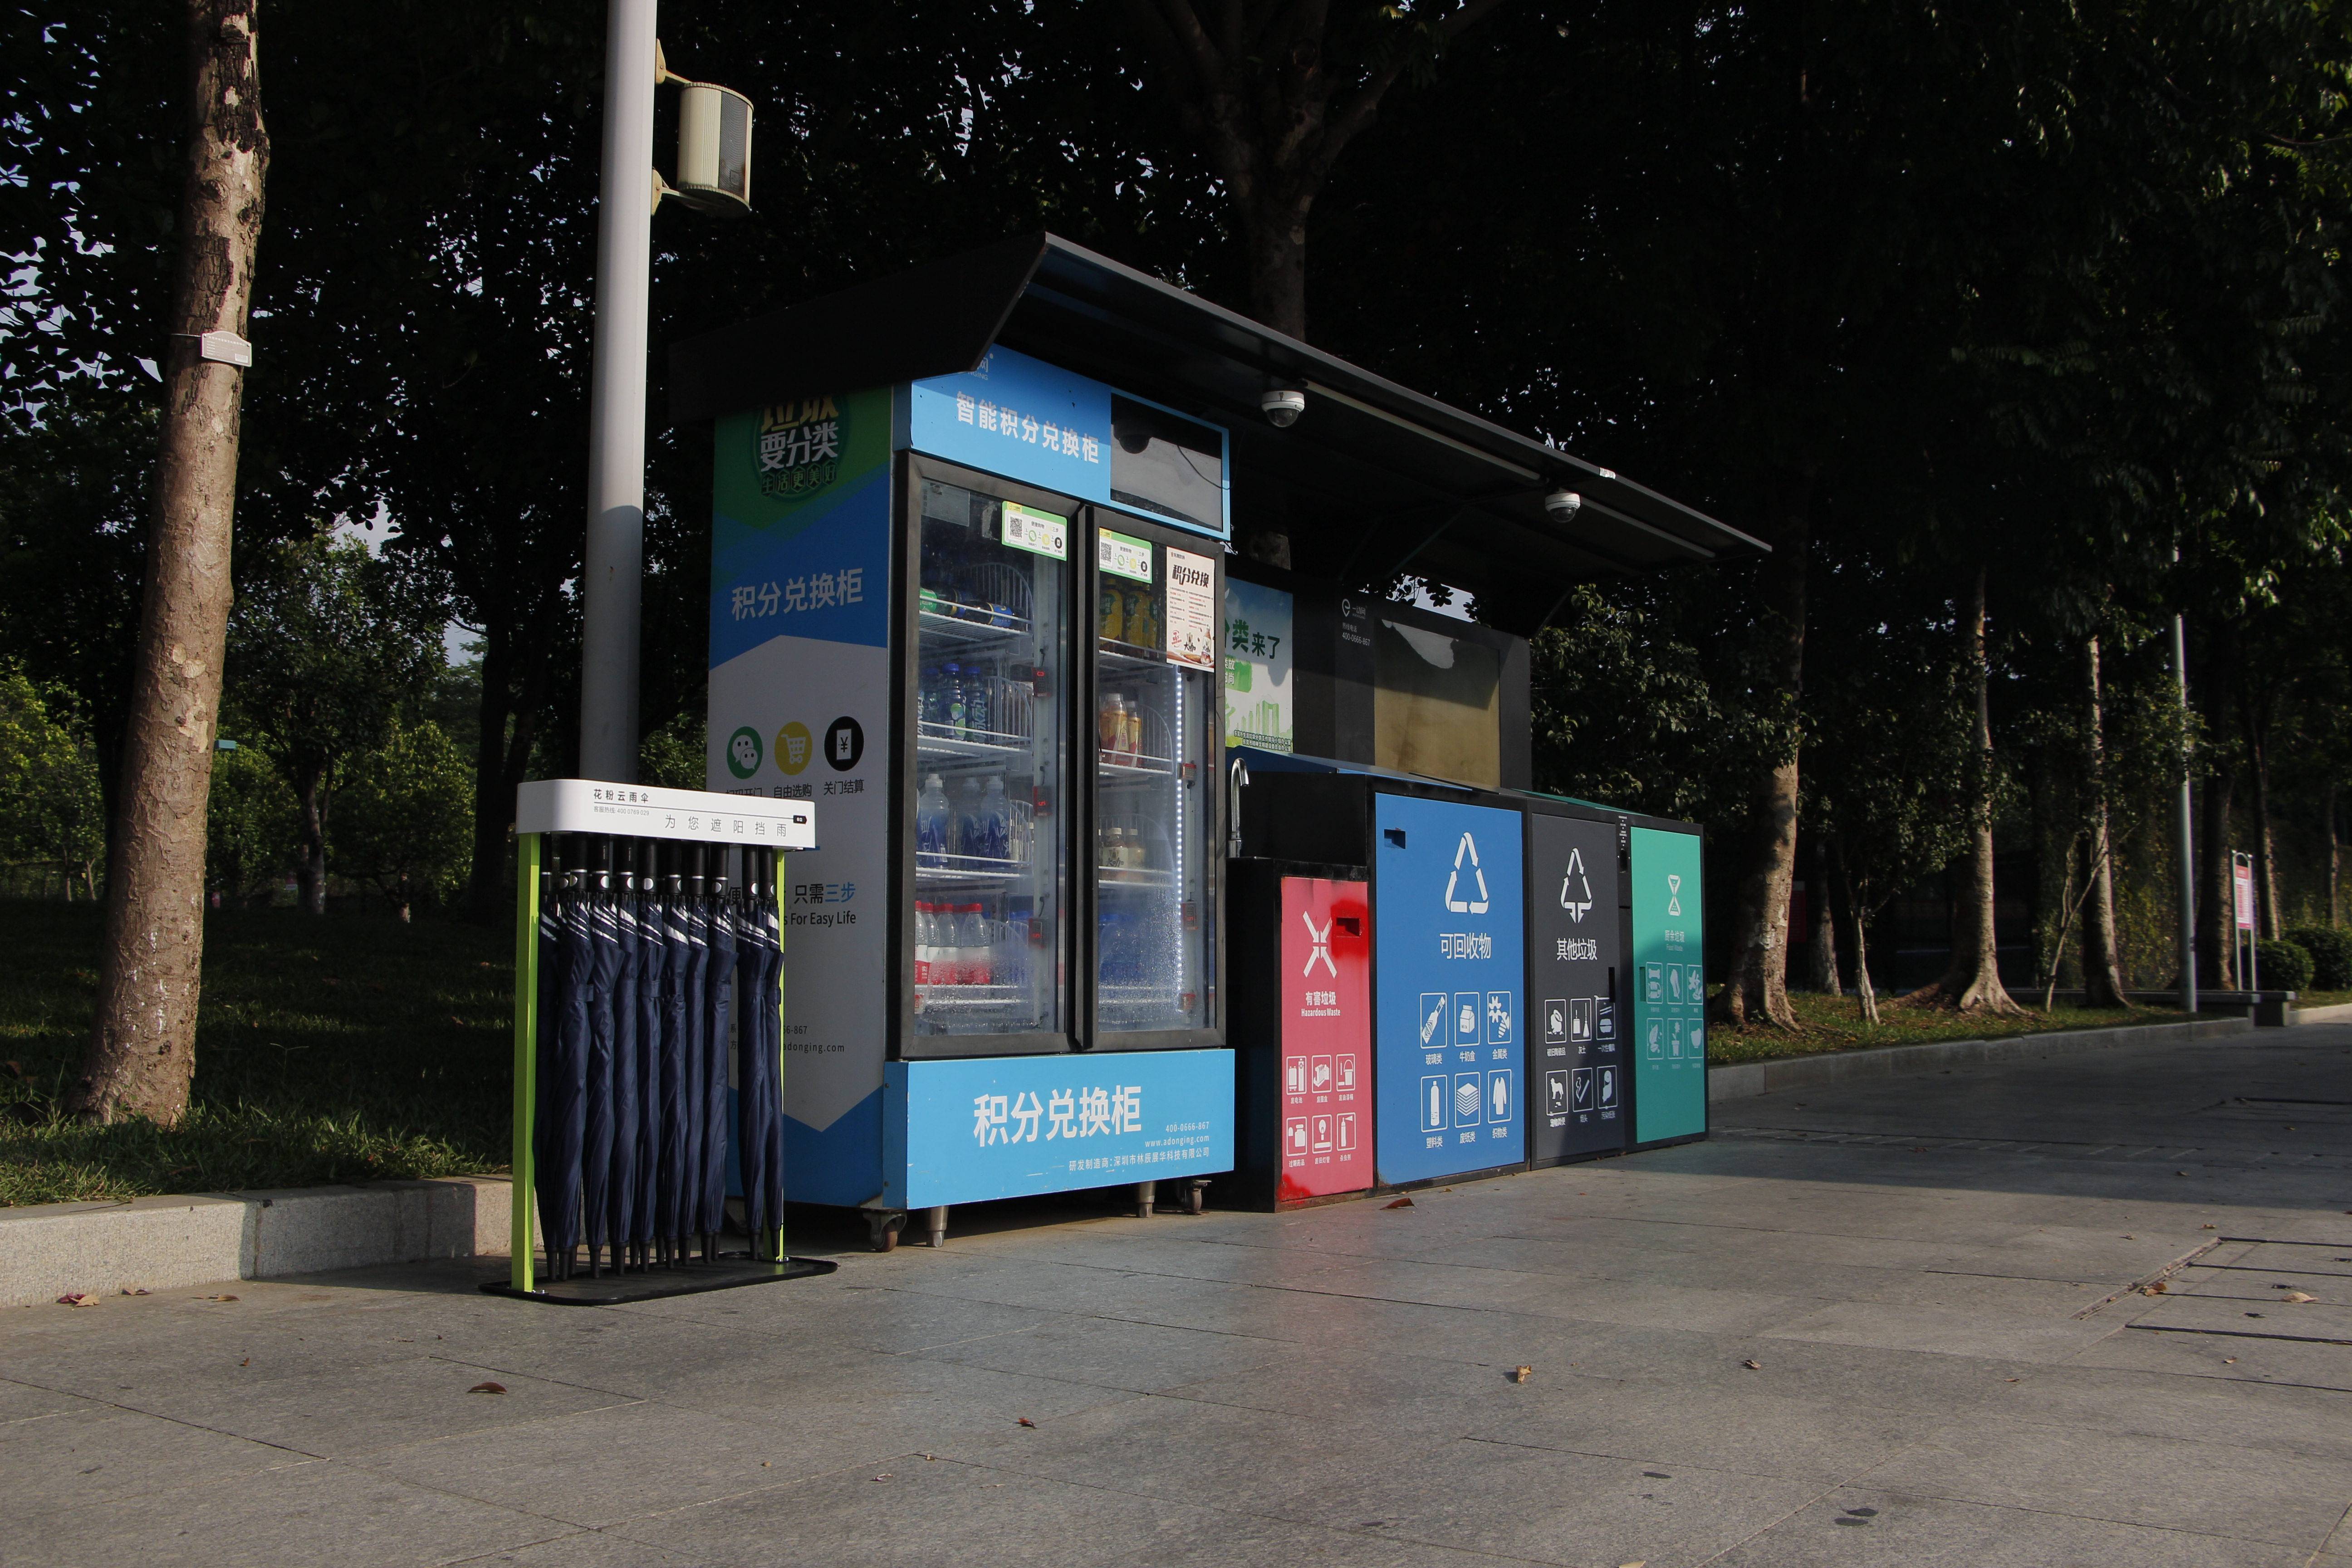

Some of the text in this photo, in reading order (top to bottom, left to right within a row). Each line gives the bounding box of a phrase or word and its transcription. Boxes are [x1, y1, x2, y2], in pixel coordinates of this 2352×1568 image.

[968, 371, 988, 381] GING
[956, 391, 1099, 463] 智能积分兑换柜
[760, 422, 838, 471] 要分类
[762, 461, 837, 495] 生活更美好
[1172, 564, 1210, 588] 积分兑换
[731, 568, 863, 621] 积分兑换柜
[1225, 617, 1280, 659] 类来了
[774, 783, 812, 798] 自由选购
[823, 779, 865, 795] 关门结算
[594, 789, 649, 804] 花粉云雨伞
[665, 813, 787, 838] 为您遮阳挡雨
[794, 882, 856, 904] 只需三步
[791, 913, 808, 925] For
[810, 912, 834, 928] Easy
[837, 910, 856, 925] Life
[1440, 932, 1492, 960] 可回收物
[1557, 937, 1597, 961] 其他垃圾
[1305, 991, 1337, 1006] 有害垃圾
[1301, 1008, 1341, 1017] Hazardous Waste
[784, 1042, 844, 1054] adonging.com
[1492, 1049, 1508, 1060] 金属类
[1426, 1053, 1442, 1065] 玻璃类
[1459, 1050, 1476, 1063] 牛奶盒
[973, 1085, 1142, 1147] 积分兑换柜
[1166, 1122, 1210, 1132] 400-0666-867
[1145, 1135, 1210, 1147] www.adonging.com
[1426, 1136, 1443, 1149] 塑料类
[1459, 1131, 1476, 1144] 废纸类
[1289, 1159, 1305, 1168] 过期药品
[1314, 1156, 1331, 1165] 废旧灯管
[1340, 1154, 1352, 1162] 杀虫剂
